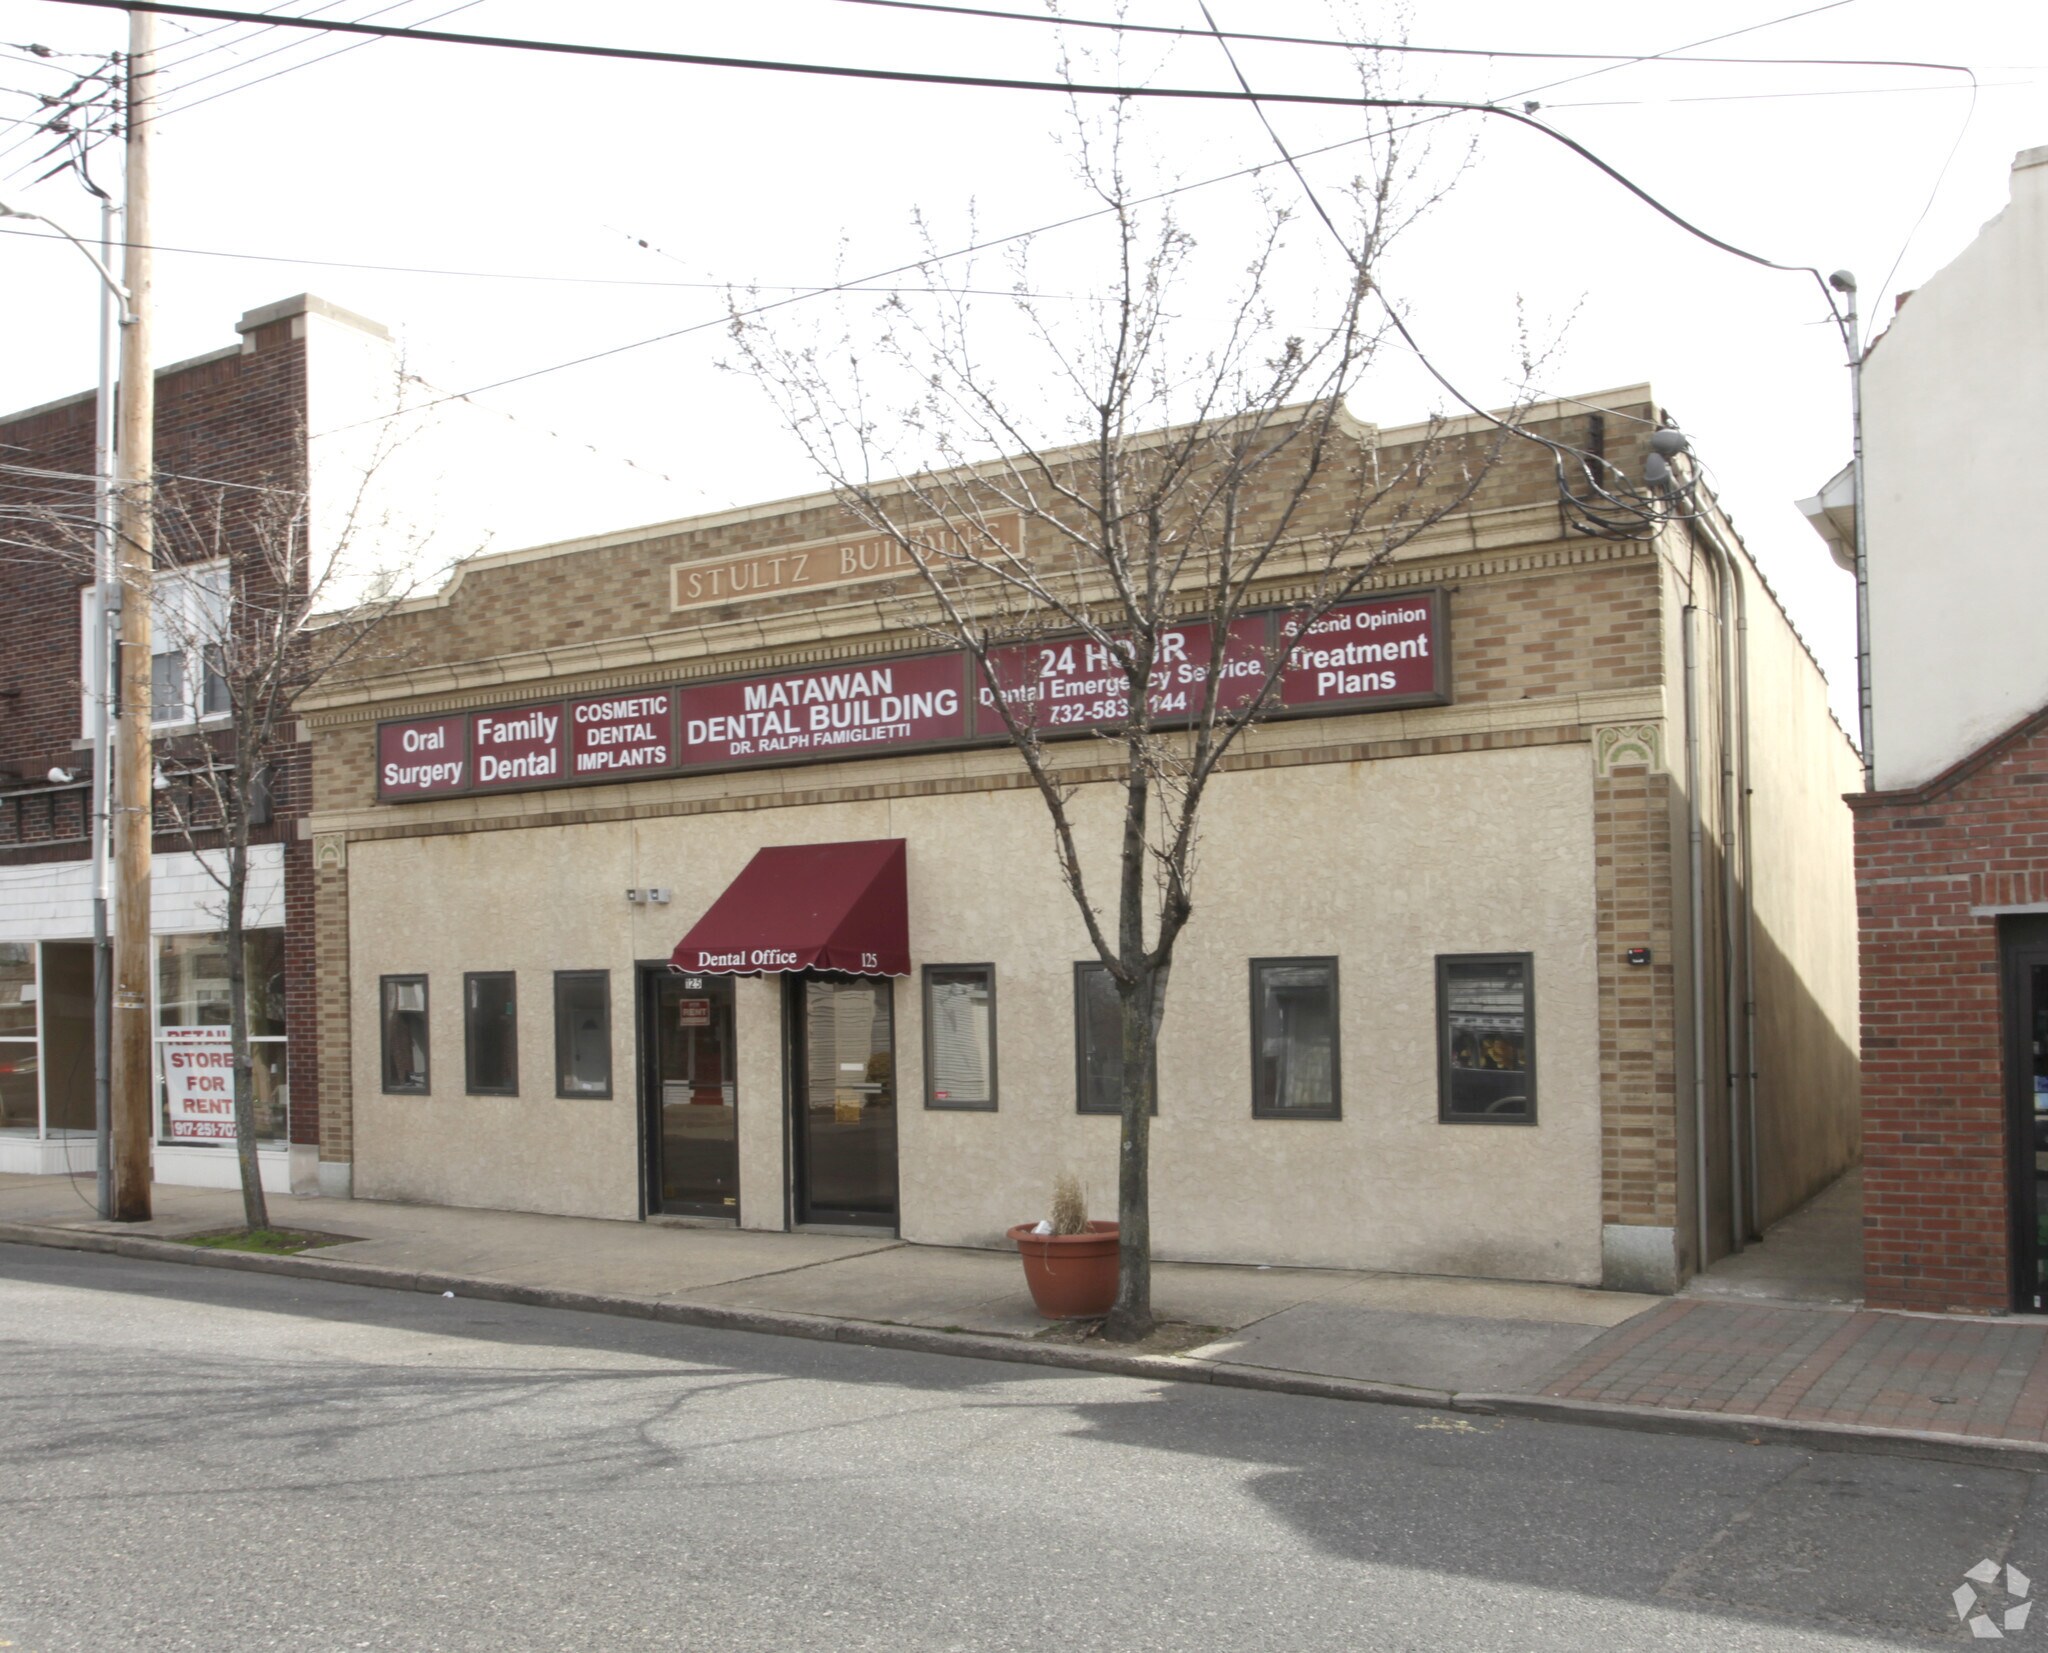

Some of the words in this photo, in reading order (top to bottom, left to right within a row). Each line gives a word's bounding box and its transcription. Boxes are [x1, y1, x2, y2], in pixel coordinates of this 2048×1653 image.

[687, 554, 810, 599] STULTZ
[1285, 614, 1352, 637] Scond
[1355, 608, 1427, 631] Opinion
[1039, 646, 1076, 678] 24
[744, 668, 893, 712] MATAWAN
[1051, 671, 1171, 699] Emergecy
[1178, 658, 1261, 684] Sevice
[1317, 670, 1397, 697] Plans
[575, 696, 668, 723] COSMETIC
[688, 709, 800, 745] DENTAL
[809, 688, 958, 732] BUILDING
[1050, 691, 1187, 724] 732-583144
[403, 727, 445, 752] Oral
[477, 711, 558, 745] Family
[587, 724, 657, 747] DENTAL
[730, 740, 755, 756] DR.
[758, 734, 809, 752] RALPH
[813, 723, 911, 747] FAMIGLIETTI
[480, 748, 556, 782] Dental
[577, 746, 667, 771] IMPLANTS
[384, 760, 463, 788] Surgery
[698, 950, 746, 967] Dental
[751, 948, 797, 965] Office
[862, 953, 878, 968] 125
[171, 1052, 234, 1068] STORE
[186, 1076, 225, 1091] FOR
[183, 1098, 232, 1114] RENT
